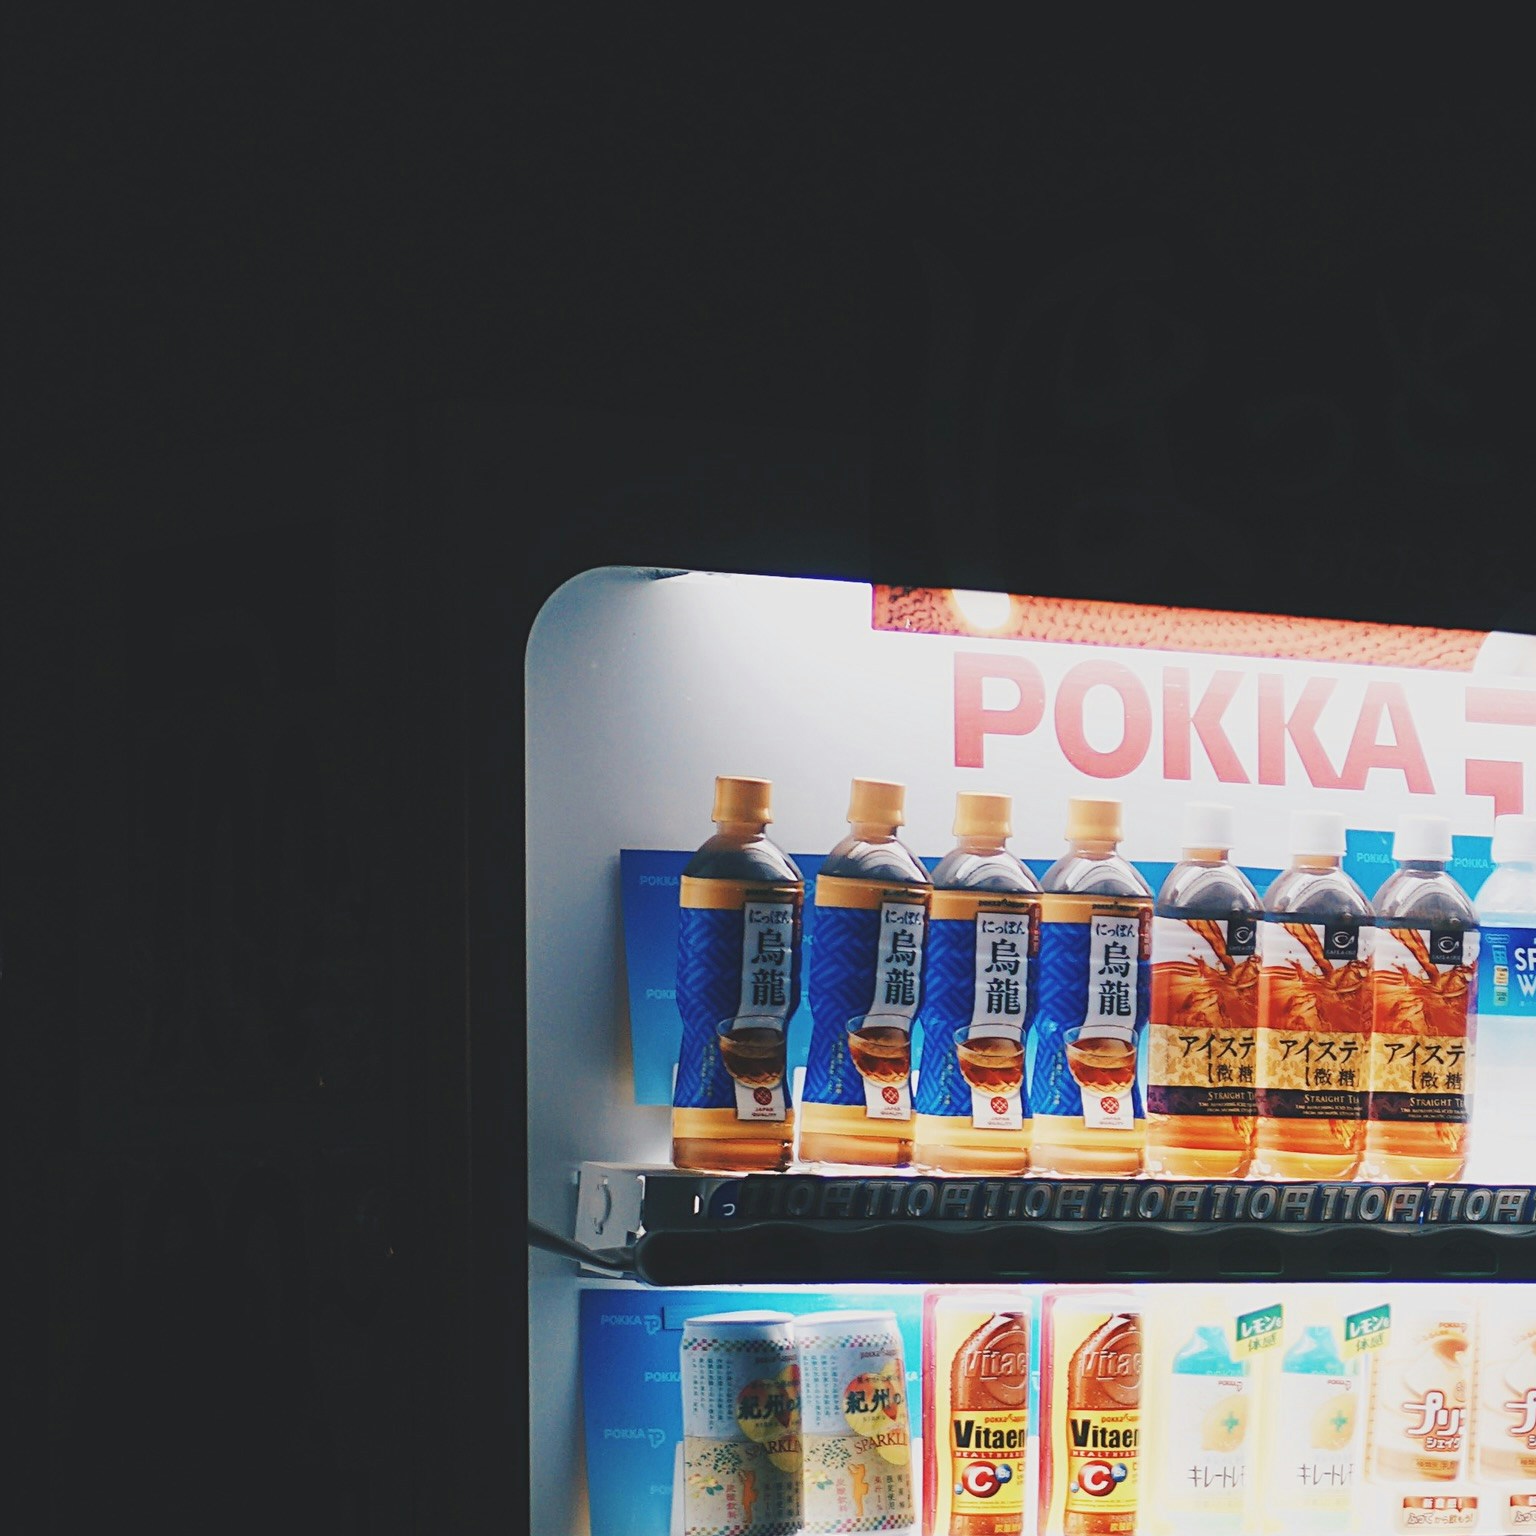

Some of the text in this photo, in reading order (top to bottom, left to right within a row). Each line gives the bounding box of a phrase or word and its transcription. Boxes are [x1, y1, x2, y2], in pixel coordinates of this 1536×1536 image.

[953, 652, 1434, 796] POKKA
[749, 909, 790, 924] にっぽん
[884, 909, 921, 925] にっぽん
[982, 920, 1026, 935] にっぽん
[1095, 923, 1136, 938] にっぽん
[751, 929, 785, 1006] 烏龍
[885, 929, 916, 1006] 烏龍
[985, 938, 1021, 1015] 烏龍
[1098, 940, 1132, 1016] 烏龍
[865, 1181, 970, 1219] 110円
[984, 1182, 1087, 1219] 110円
[1100, 1183, 1201, 1221] 110円
[1211, 1184, 1313, 1221] 110円
[1320, 1185, 1423, 1222] 110円
[1430, 1188, 1530, 1223] 110円
